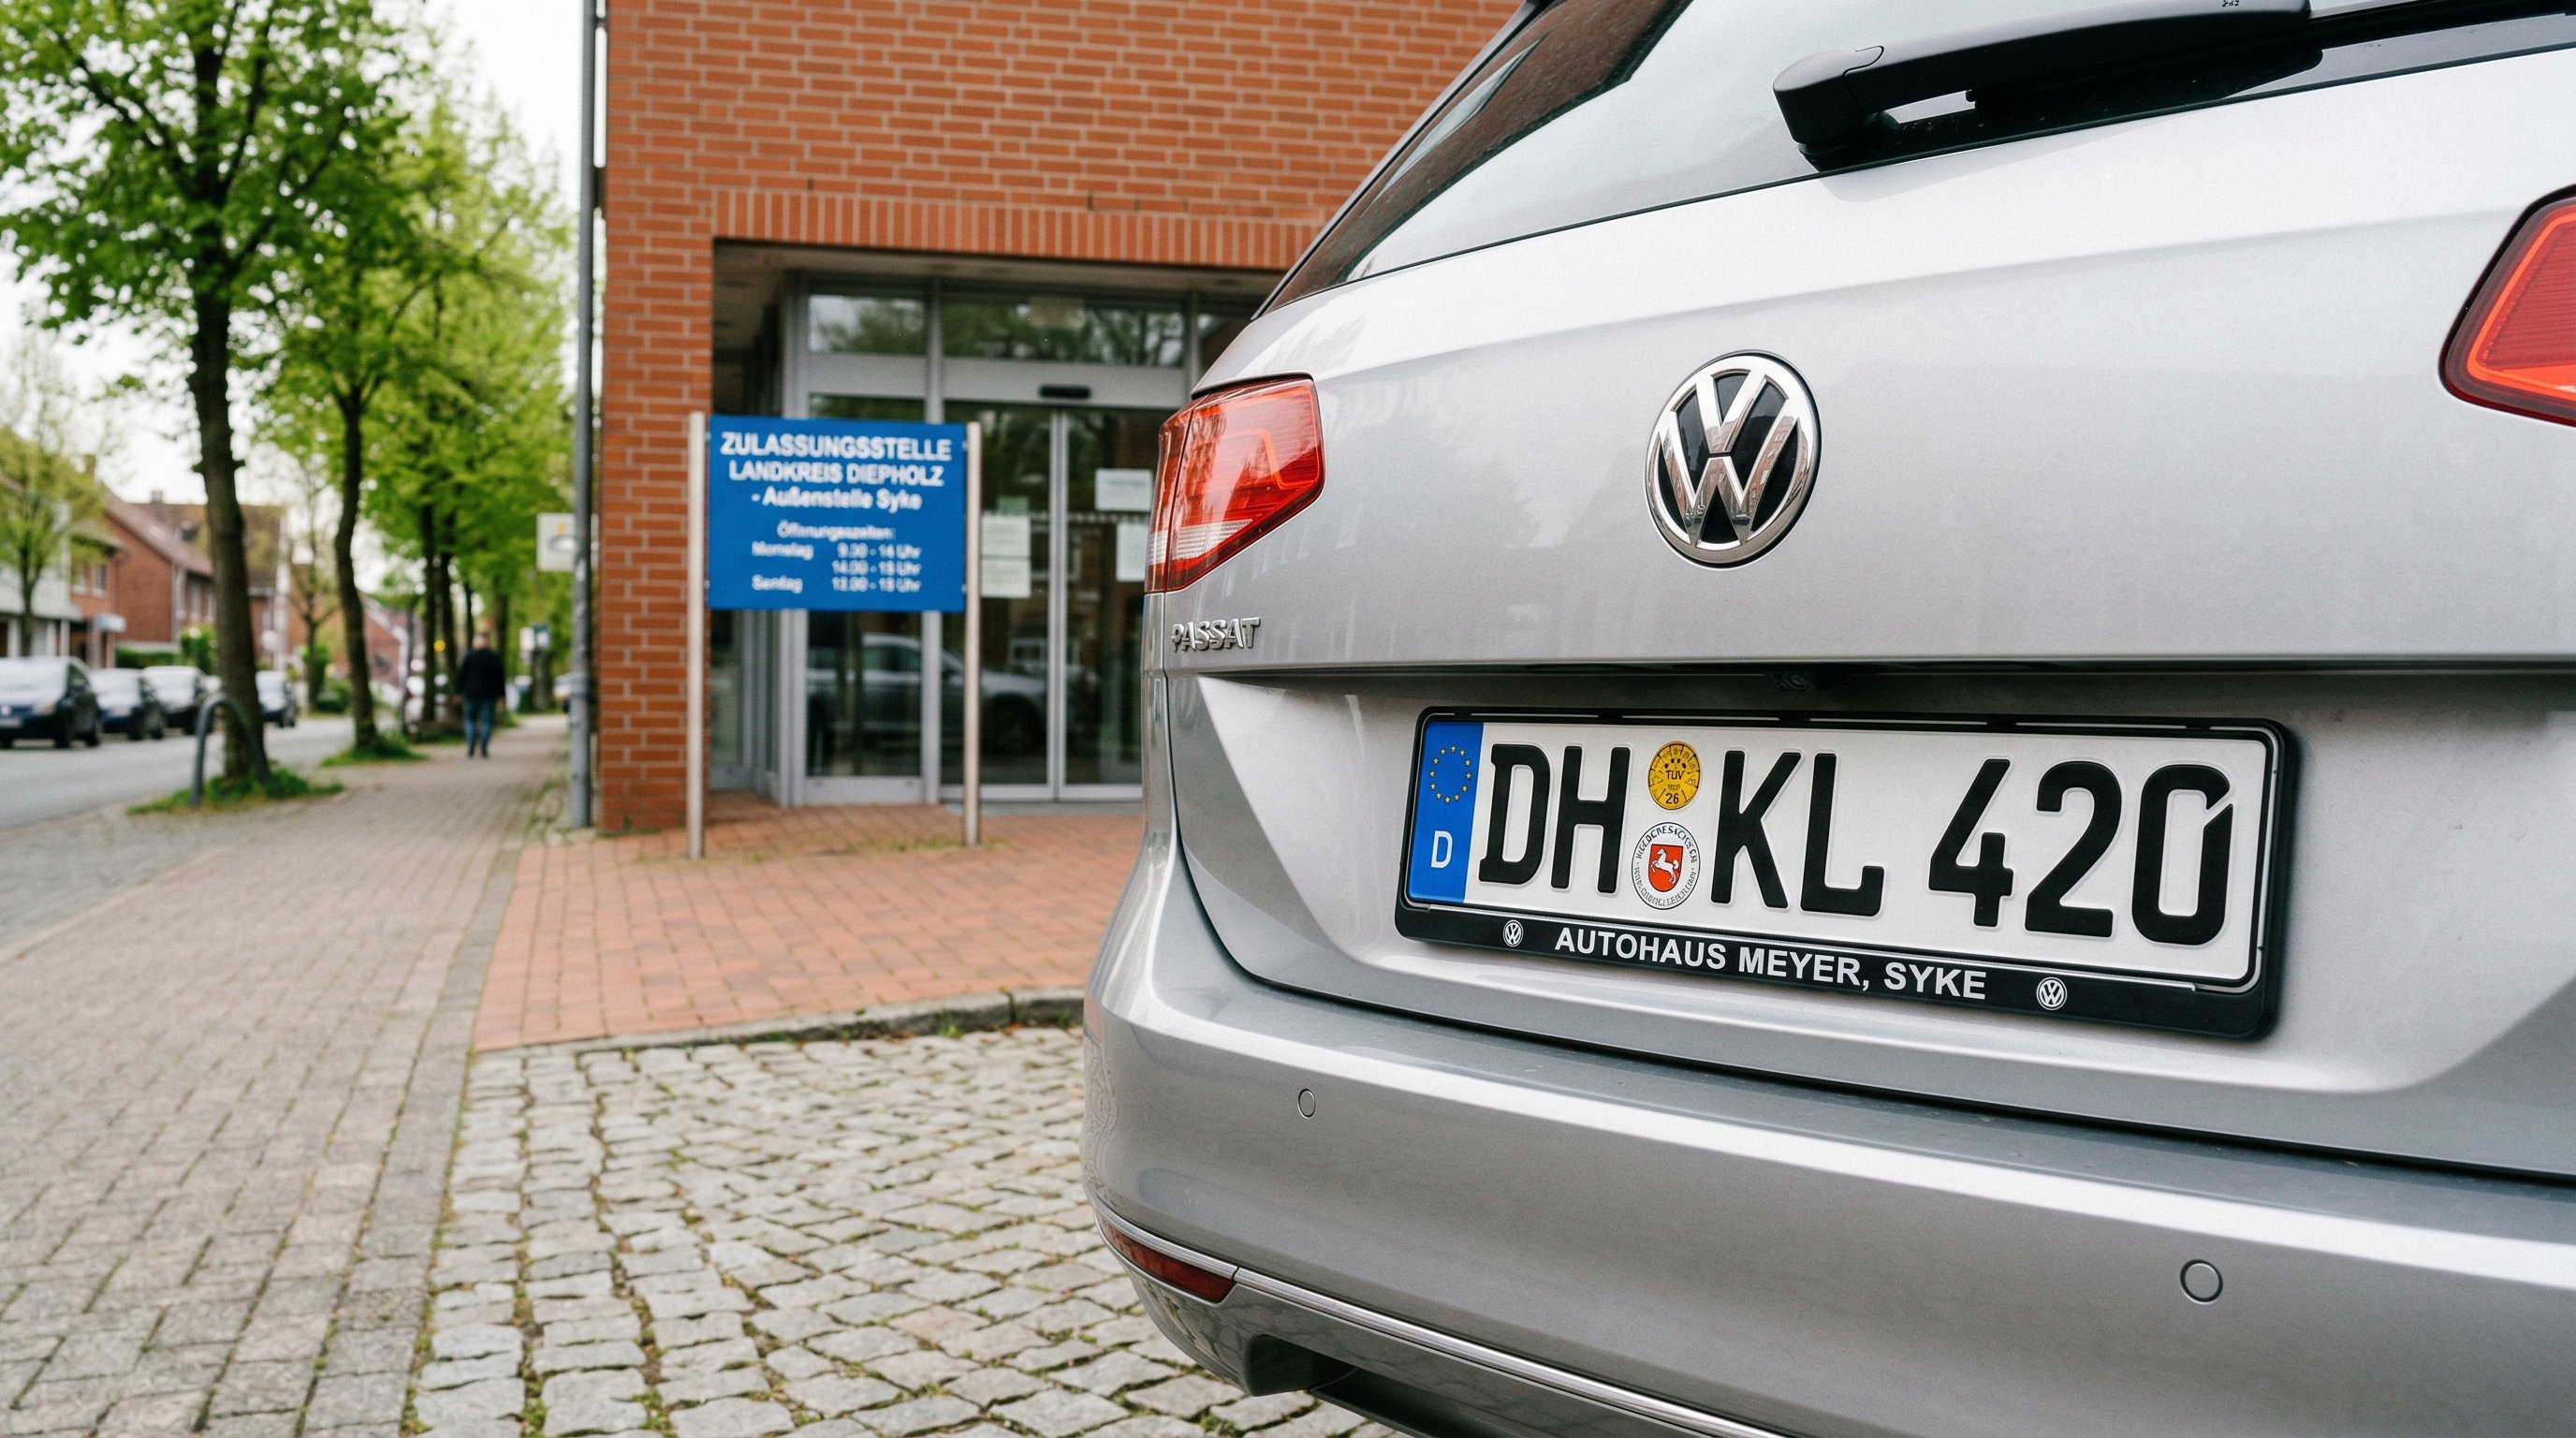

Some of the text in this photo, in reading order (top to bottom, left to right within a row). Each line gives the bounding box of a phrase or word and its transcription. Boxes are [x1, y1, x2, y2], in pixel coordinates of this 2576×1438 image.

[720, 432, 952, 462] ZULASSUNGSSTELLE
[729, 460, 944, 487] LANDKREIS DIEPHOLZ
[876, 488, 922, 514] Syke
[1171, 617, 1261, 652] PASSAT
[1665, 792, 1680, 804] 26
[1430, 830, 1454, 869] D
[1478, 742, 2235, 946] DH KL 420
[1554, 927, 1987, 1000] AUTOHAUS MEYER, SYKE
